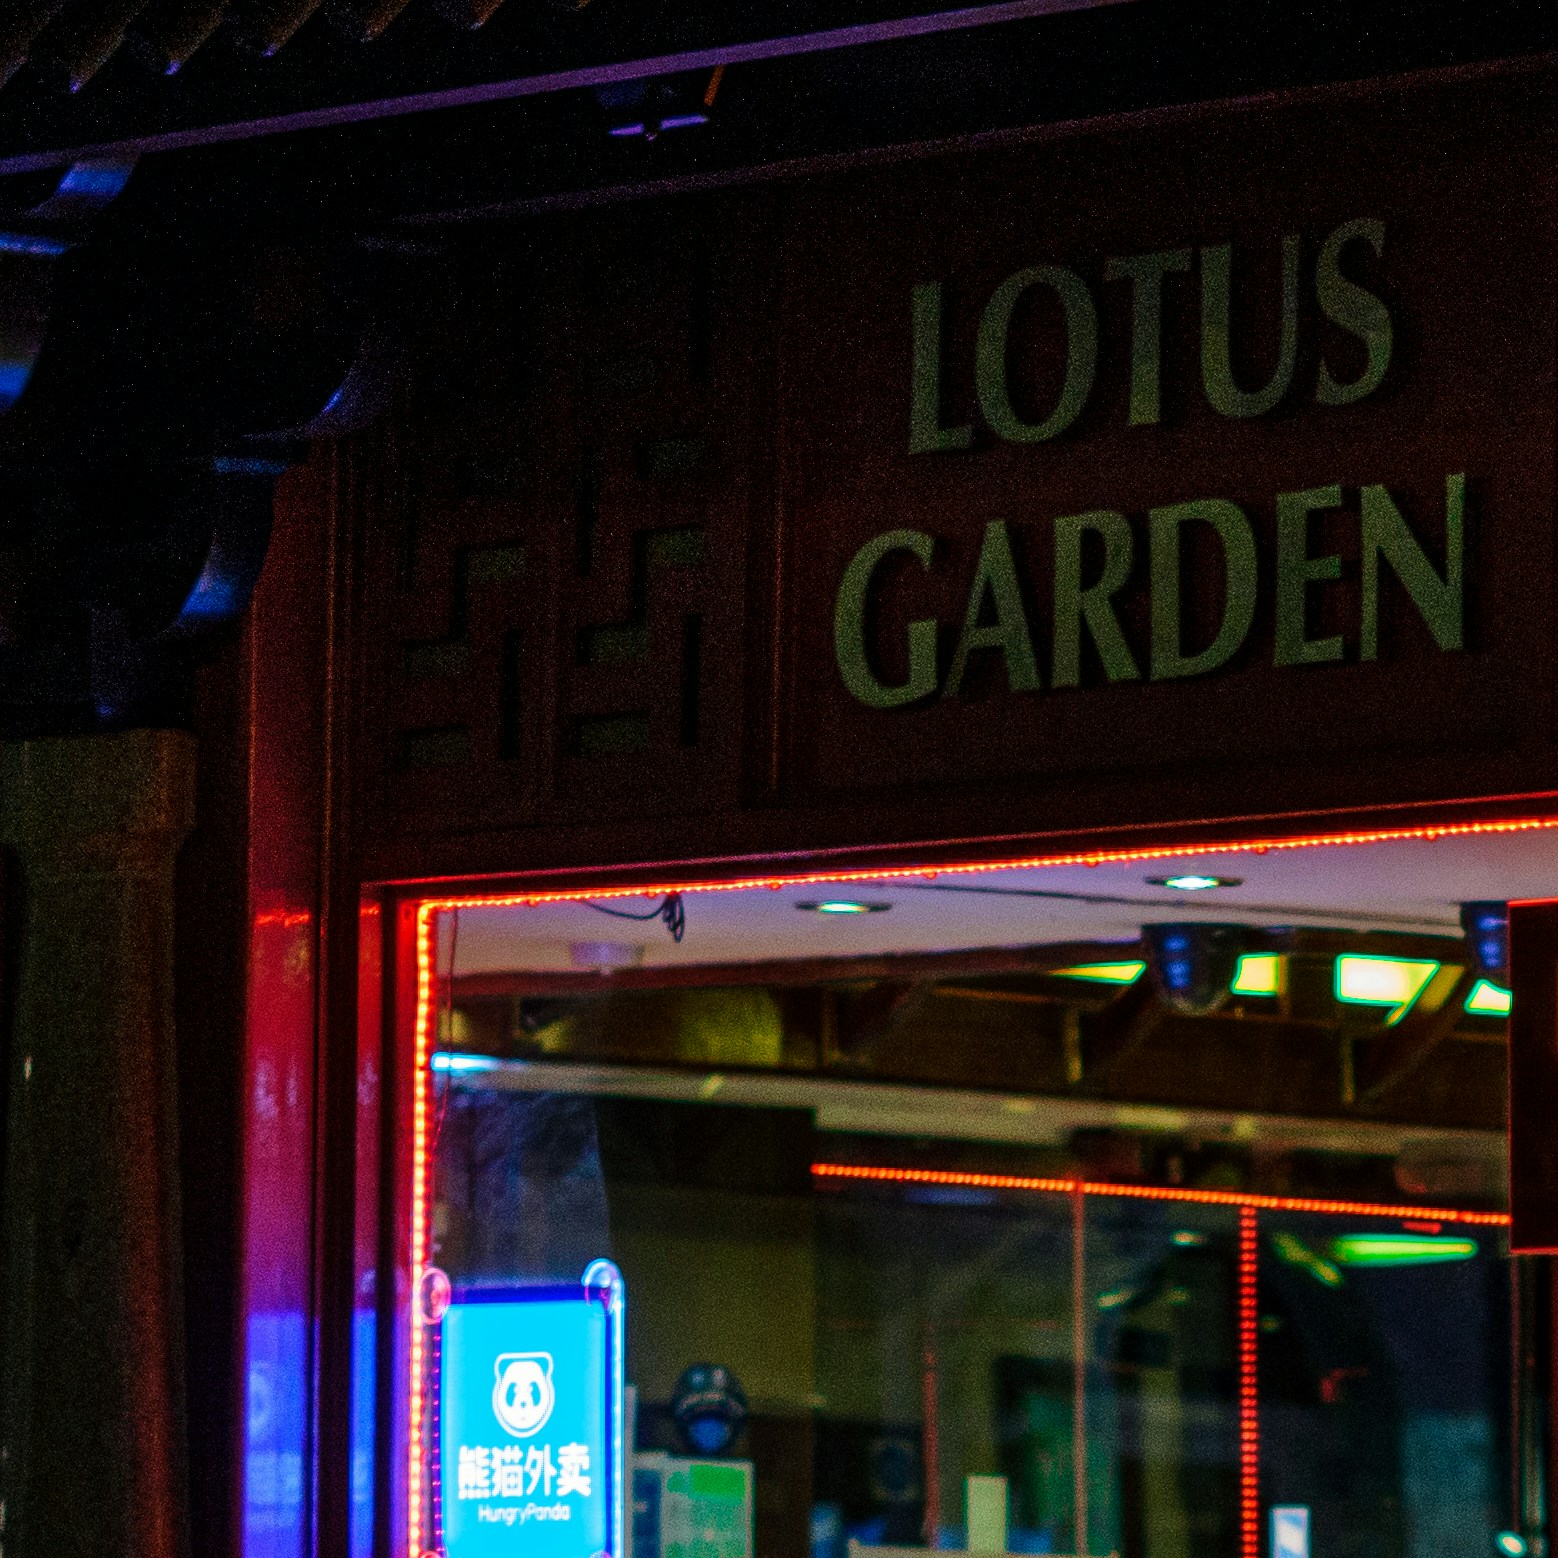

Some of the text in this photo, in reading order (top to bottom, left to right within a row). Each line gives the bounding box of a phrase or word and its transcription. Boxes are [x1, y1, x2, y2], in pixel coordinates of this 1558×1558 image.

[908, 216, 1393, 456] LOTUS
[832, 471, 1466, 708] GARDEN
[457, 1441, 592, 1500] 熊猫外卖
[477, 1502, 571, 1526] HungryPanda
